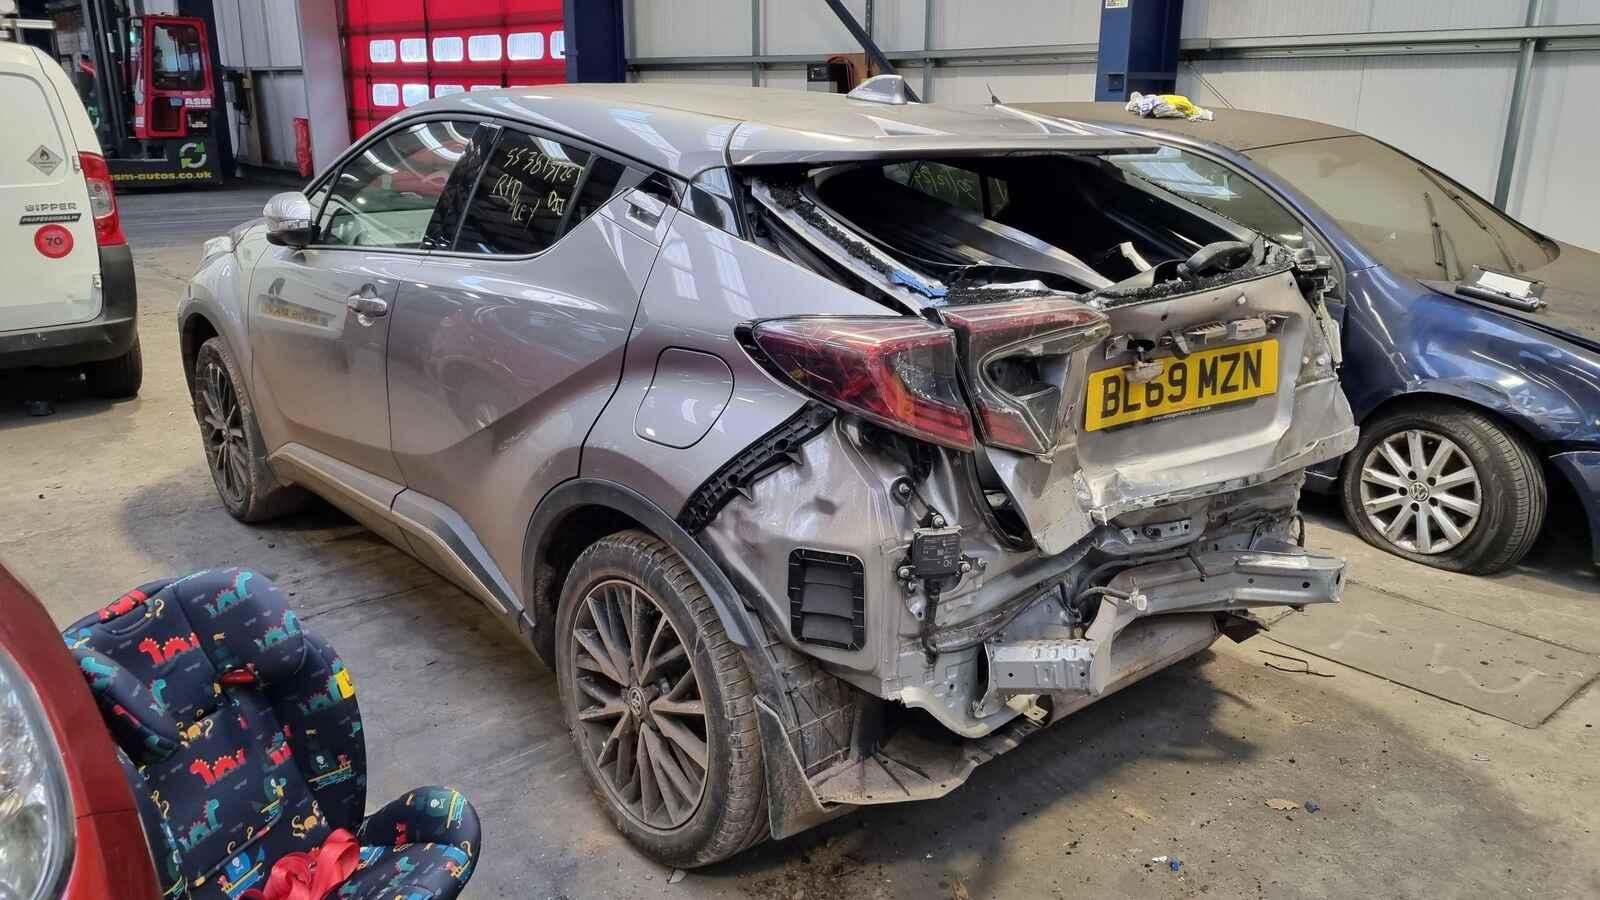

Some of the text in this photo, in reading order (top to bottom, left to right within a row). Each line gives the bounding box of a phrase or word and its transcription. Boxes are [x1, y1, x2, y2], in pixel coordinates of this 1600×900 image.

[184, 97, 212, 106] ASM
[46, 236, 63, 247] 70
[1101, 348, 1263, 419] BL69 MZN
